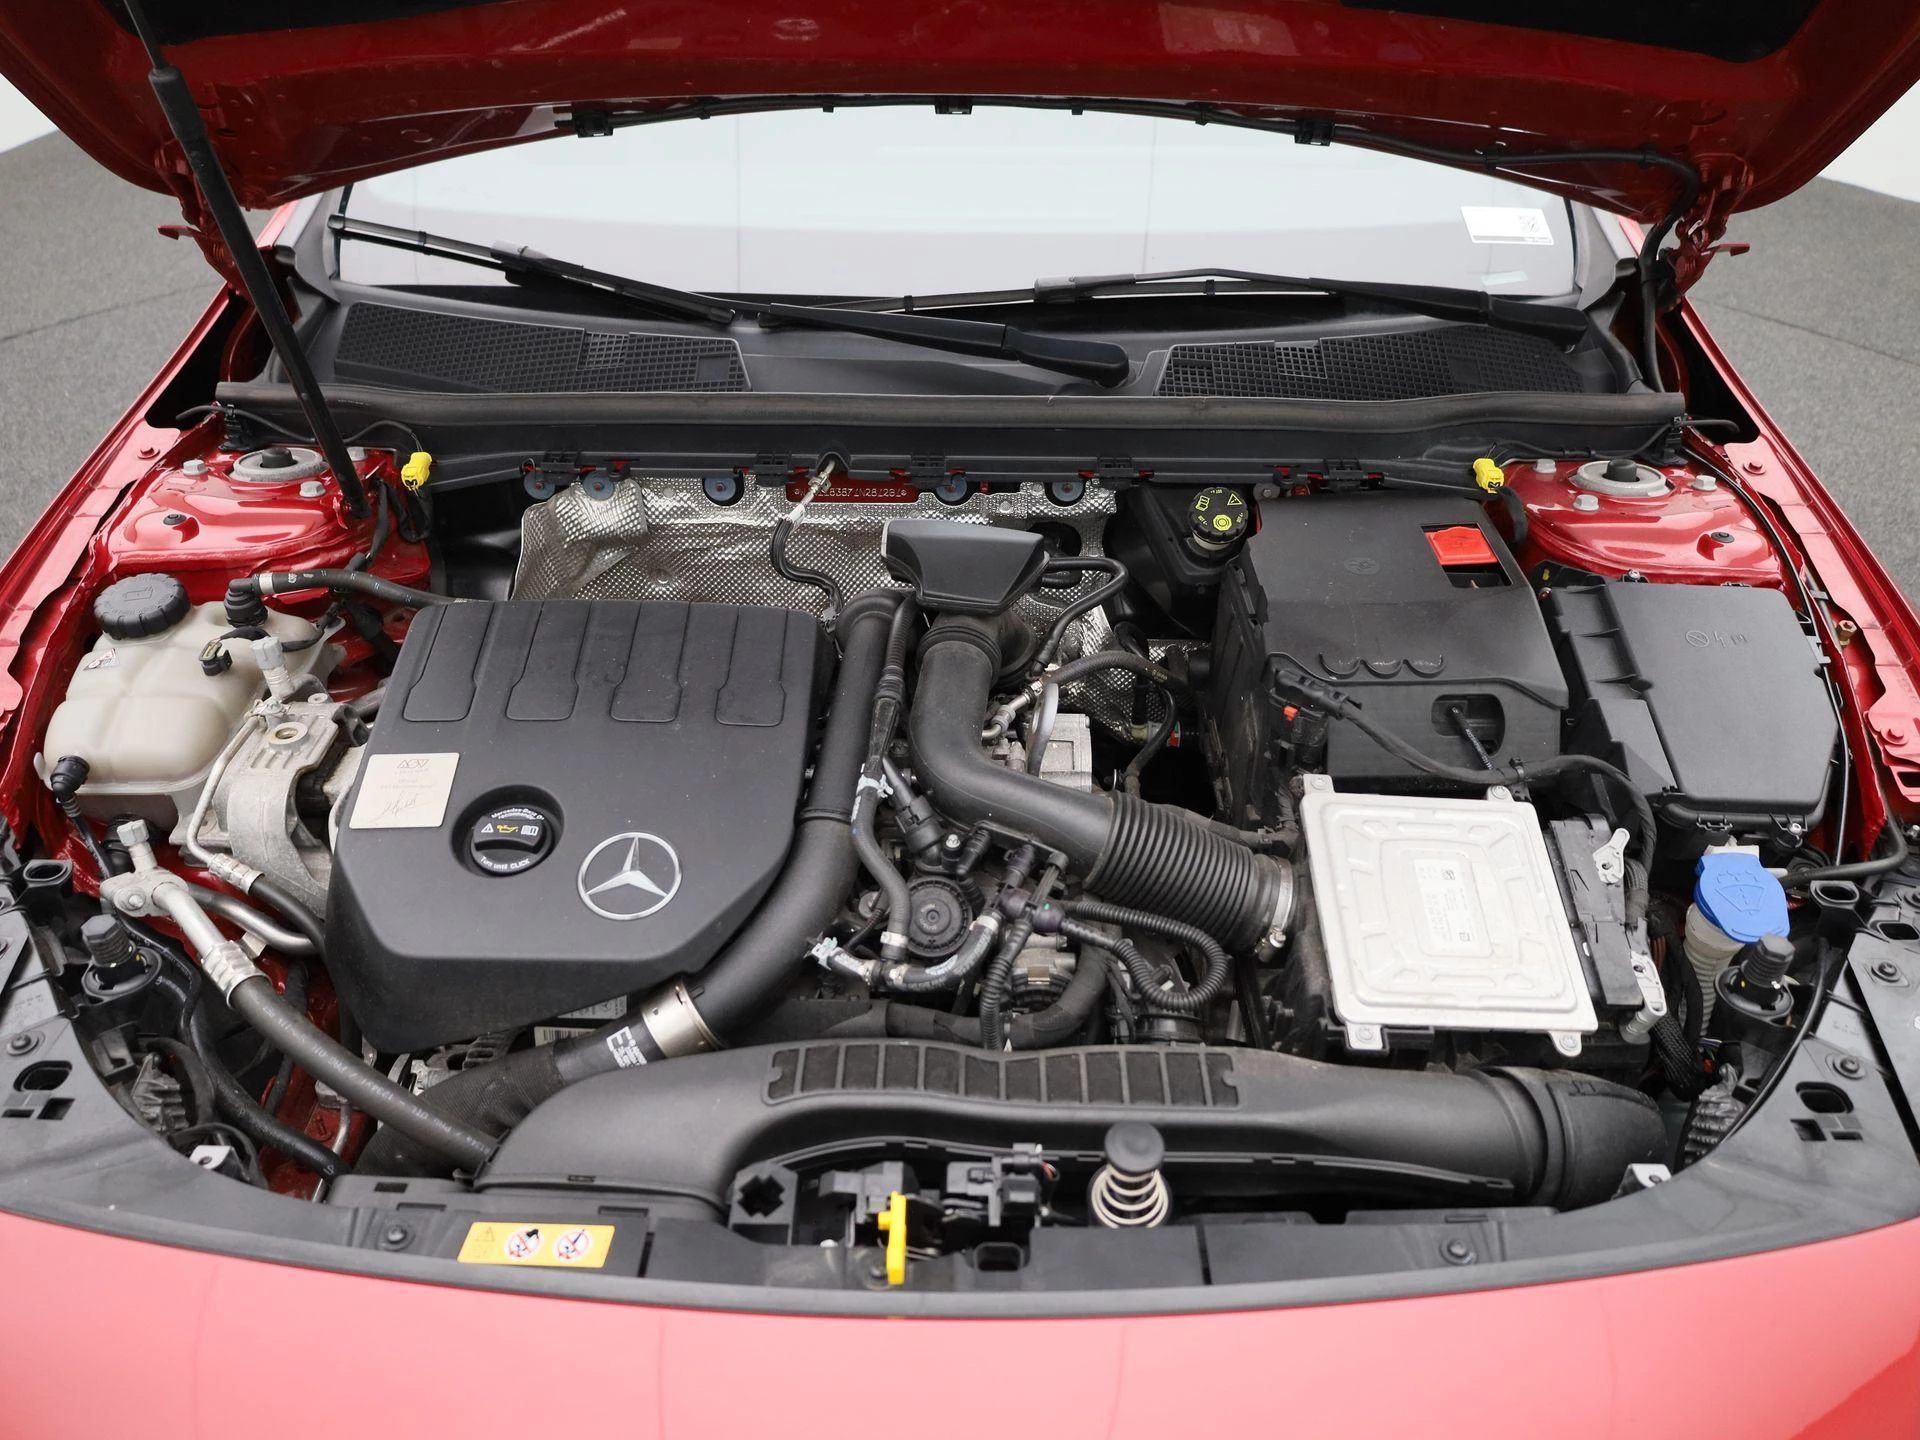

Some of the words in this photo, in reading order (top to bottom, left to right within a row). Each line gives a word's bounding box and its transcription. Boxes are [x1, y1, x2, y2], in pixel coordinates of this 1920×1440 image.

[480, 855, 493, 868] Turn
[493, 863, 508, 871] until
[510, 858, 530, 870] CLICK
